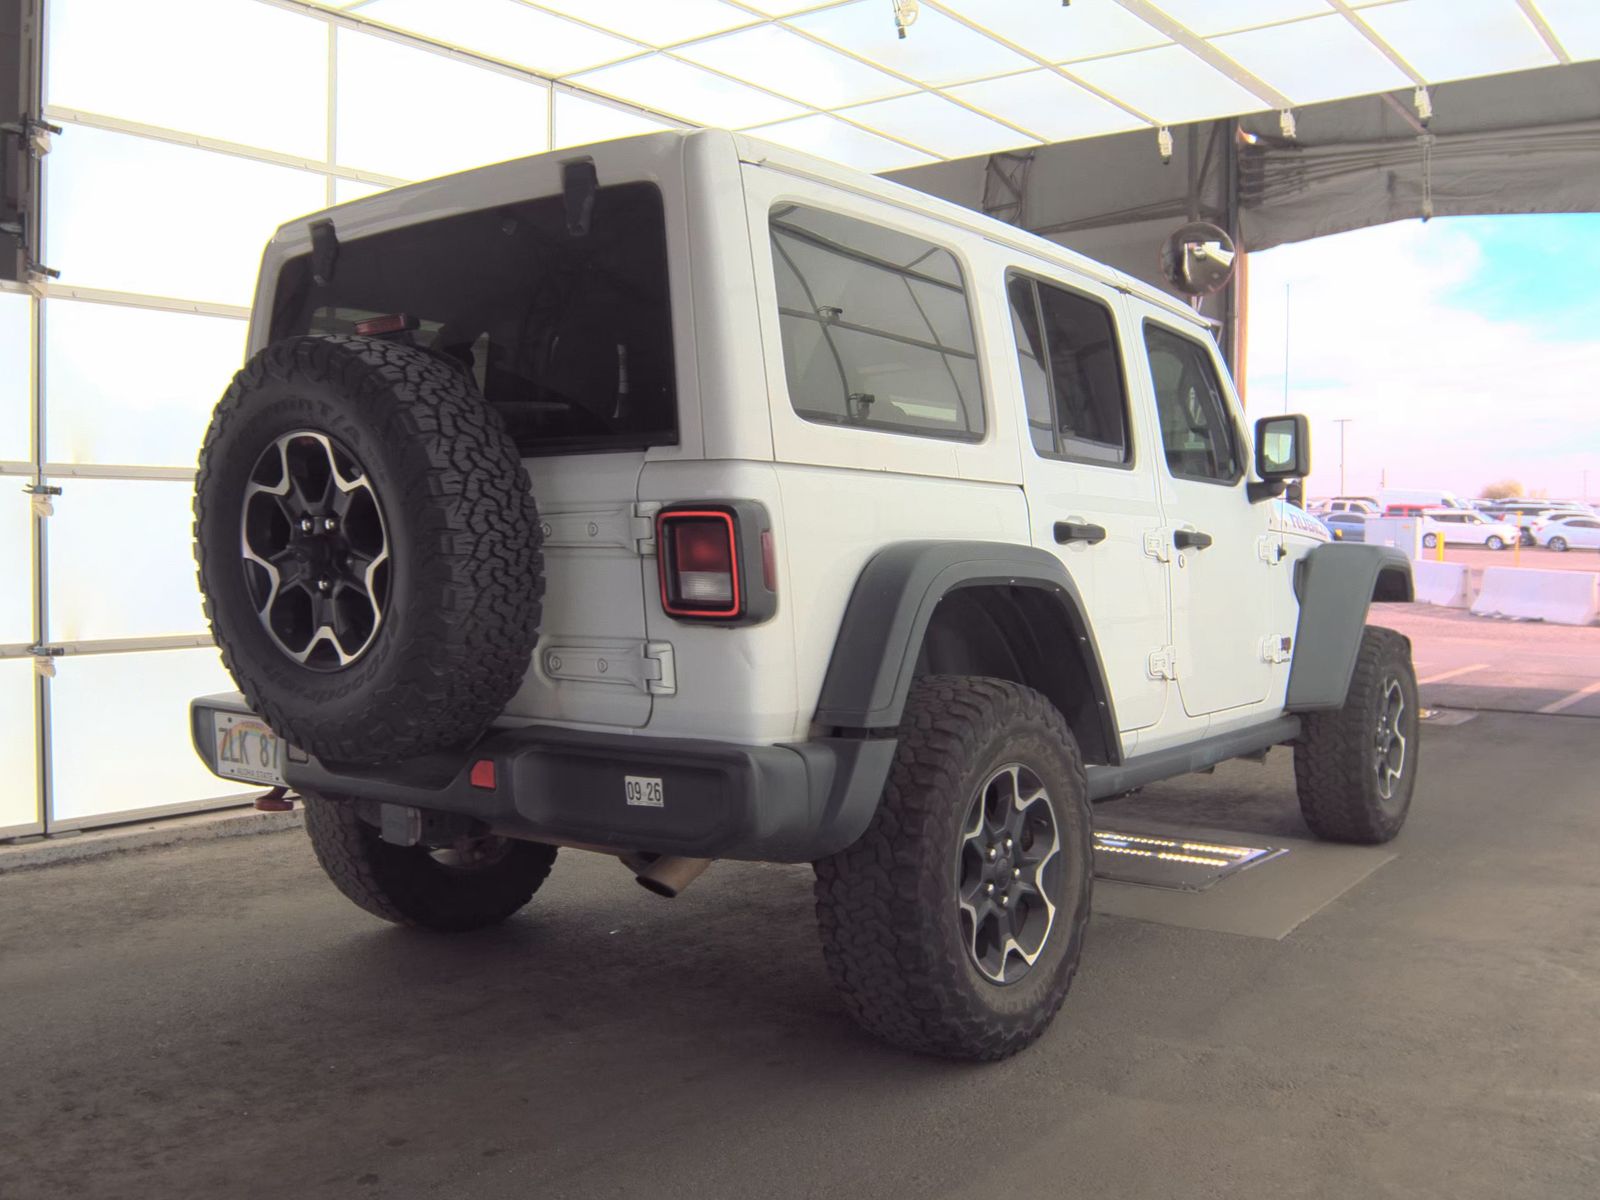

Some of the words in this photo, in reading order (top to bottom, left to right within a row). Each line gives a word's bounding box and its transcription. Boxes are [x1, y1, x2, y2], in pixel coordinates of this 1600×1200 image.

[219, 728, 250, 765] ZLK
[627, 781, 642, 801] 09
[646, 782, 662, 802] 26
